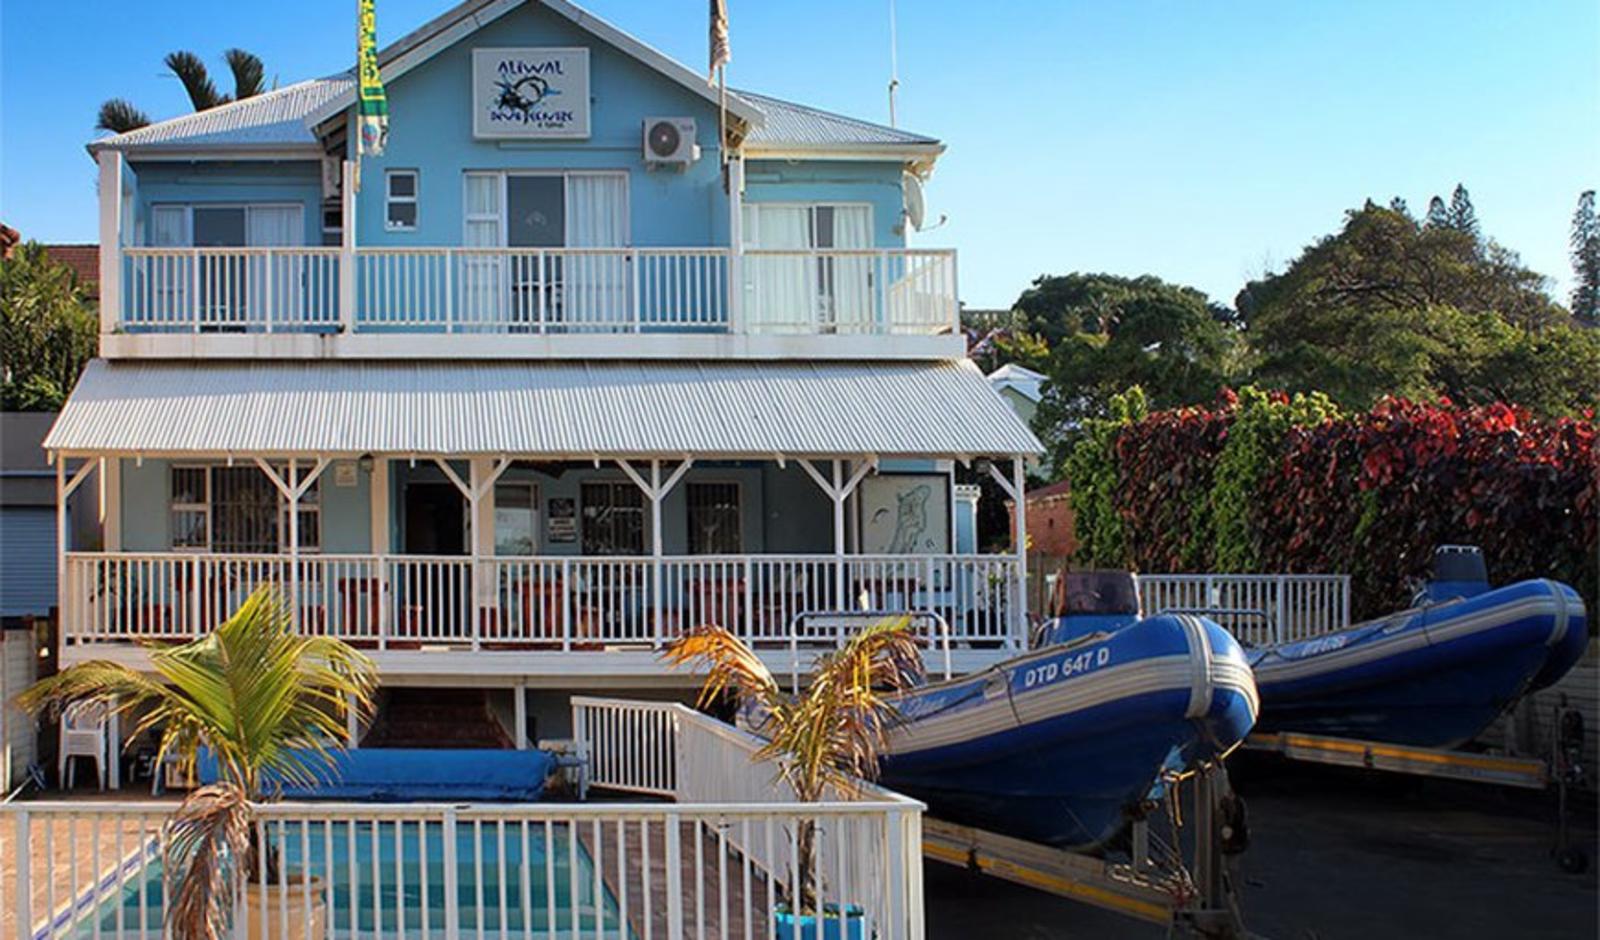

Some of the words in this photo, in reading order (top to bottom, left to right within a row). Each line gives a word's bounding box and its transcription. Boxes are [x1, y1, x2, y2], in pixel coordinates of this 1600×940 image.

[1024, 663, 1058, 687] DTD
[1062, 652, 1093, 676] 647
[1097, 648, 1109, 666] D
